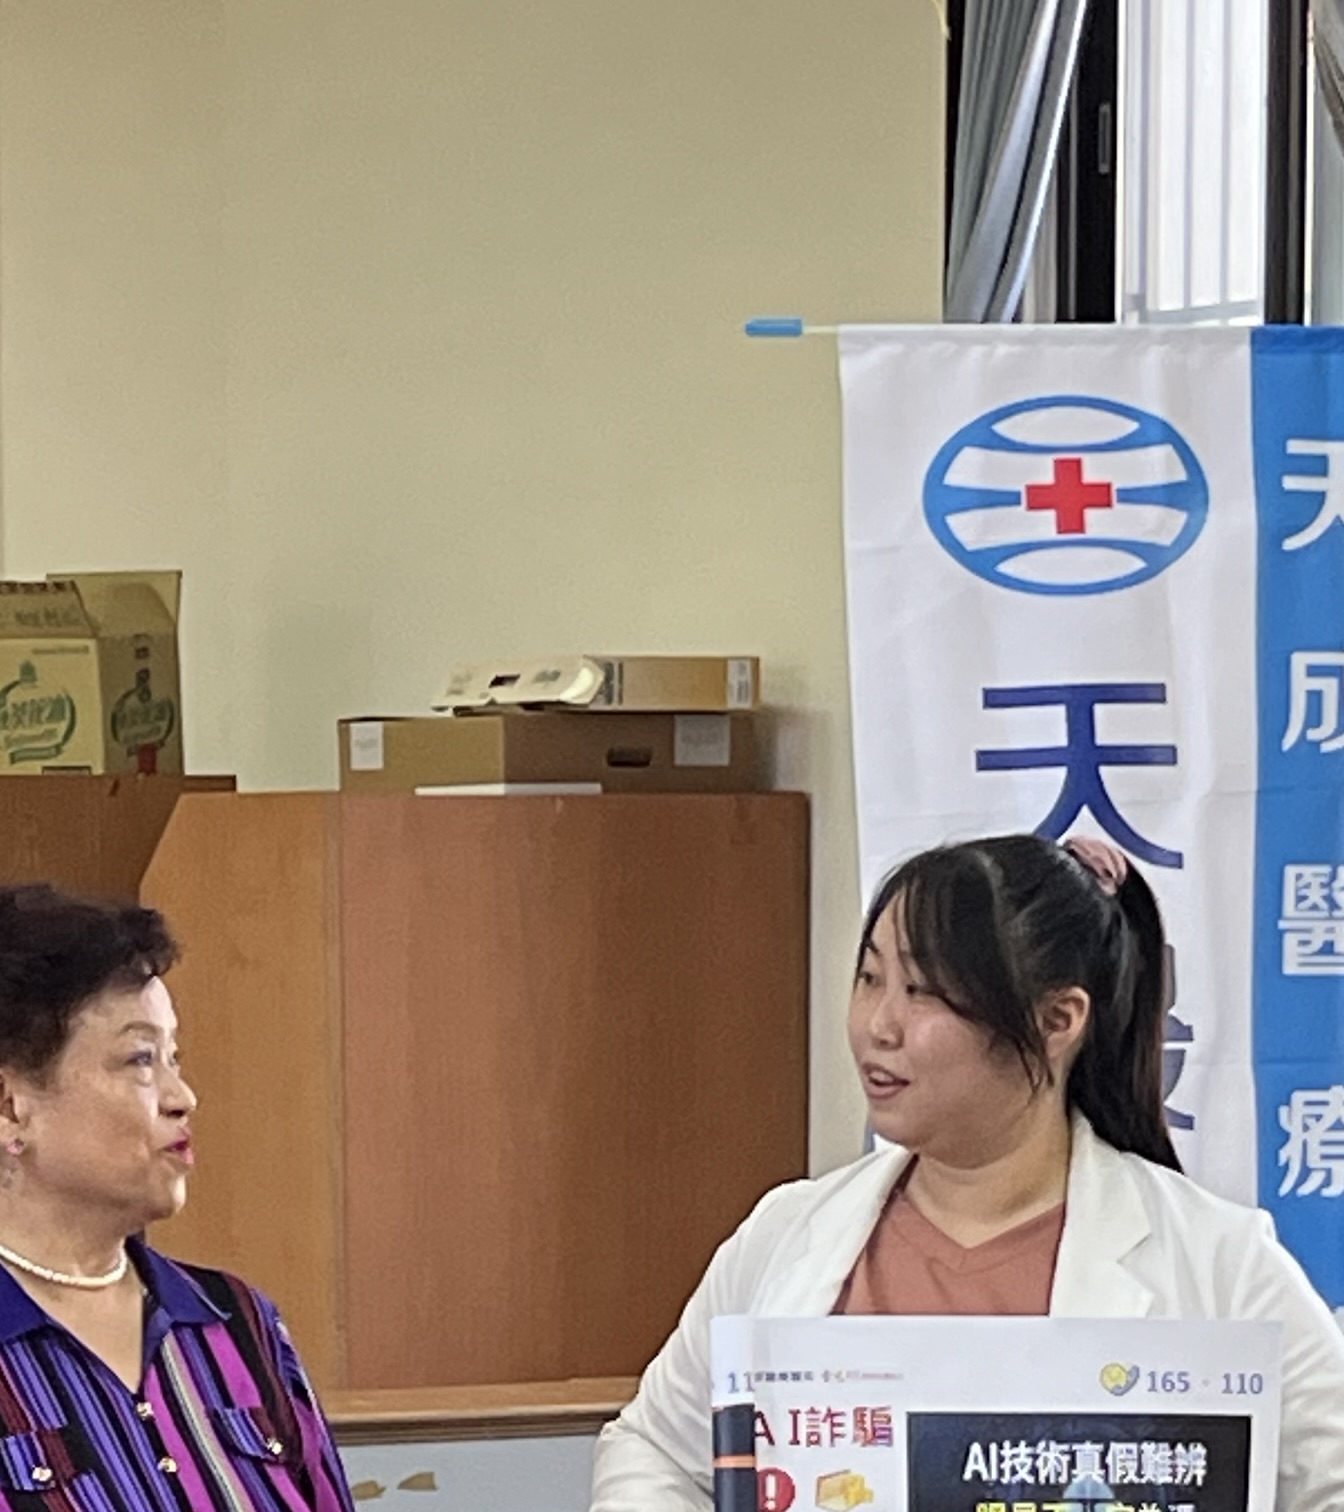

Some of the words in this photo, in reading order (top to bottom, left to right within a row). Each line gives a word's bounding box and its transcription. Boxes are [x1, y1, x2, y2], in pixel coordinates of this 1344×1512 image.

[1147, 1370, 1190, 1393] 165
[1221, 1373, 1264, 1395] 110
[963, 1440, 1208, 1486] AI技術真假難辨
